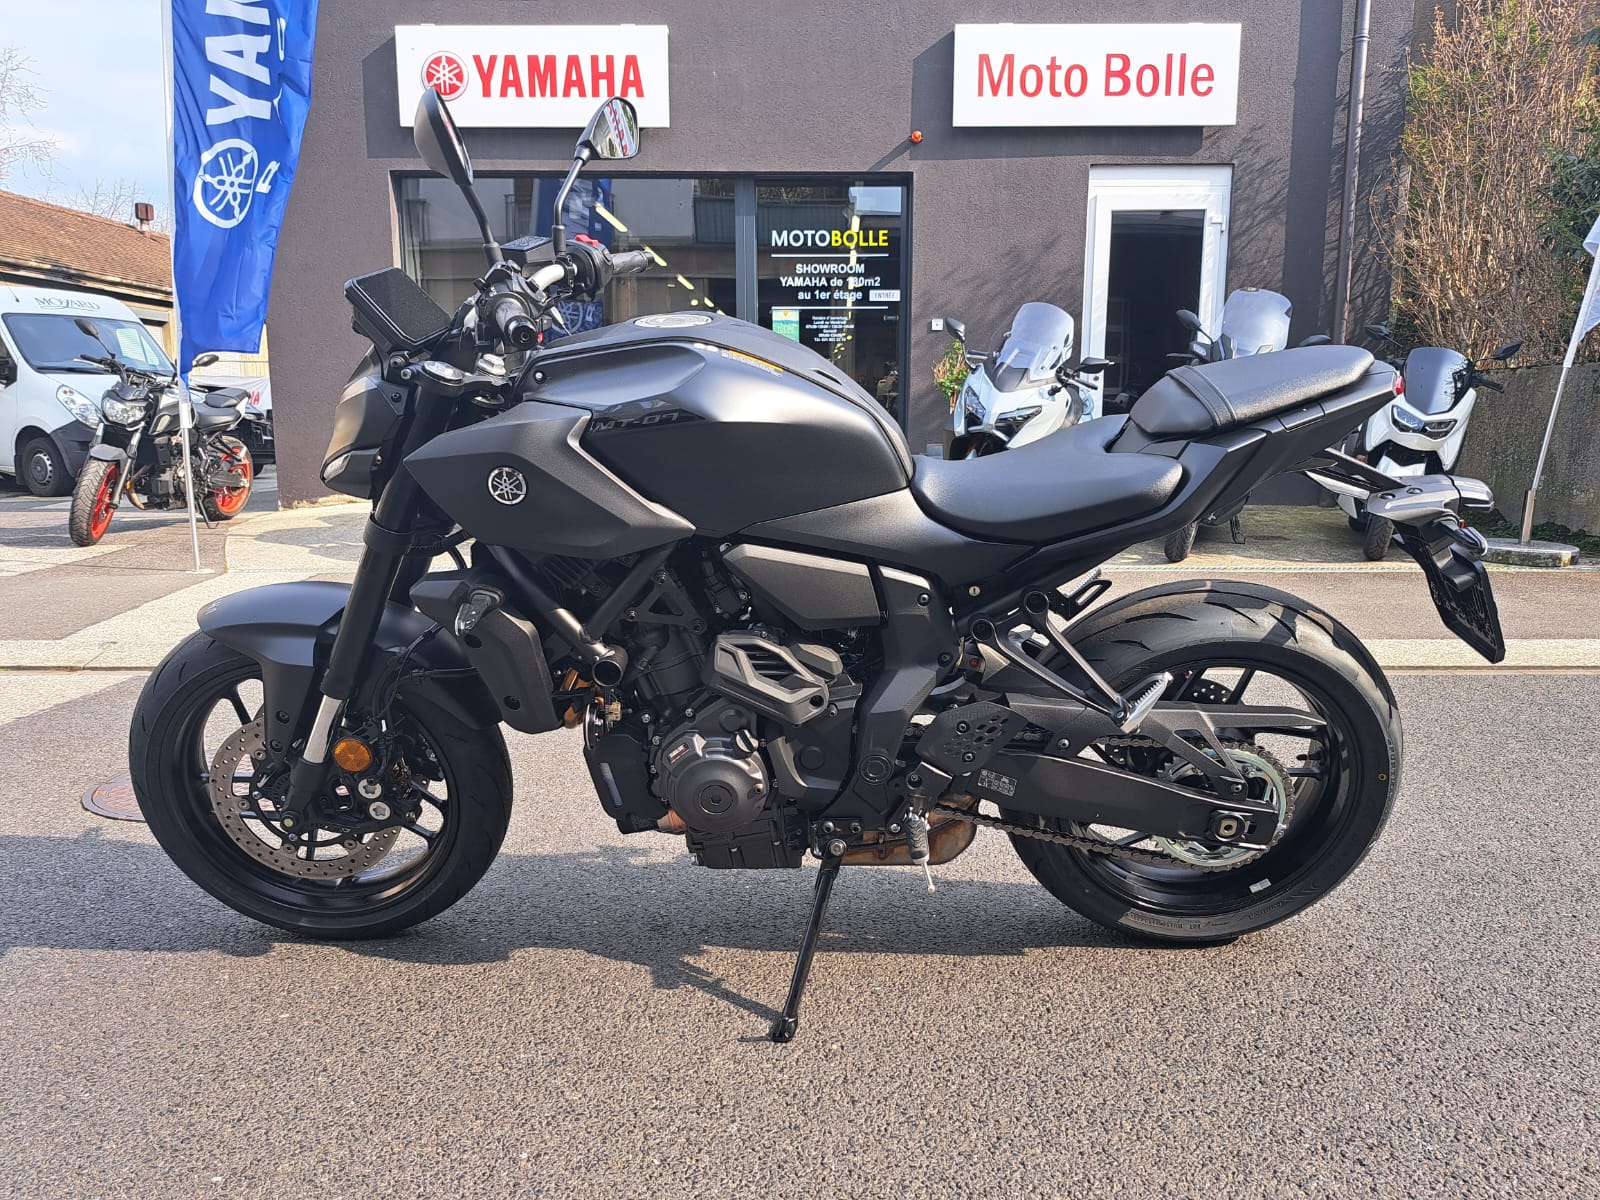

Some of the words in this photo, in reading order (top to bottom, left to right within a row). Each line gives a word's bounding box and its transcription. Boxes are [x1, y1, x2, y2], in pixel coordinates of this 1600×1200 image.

[472, 54, 645, 98] YAMAHA
[977, 53, 1088, 98] Moto
[1103, 52, 1216, 97] Bolle
[771, 229, 889, 247] MOTOBOLLE
[795, 263, 866, 274] SHOWROOM
[779, 276, 828, 287] YAMAHA
[829, 276, 843, 287] de
[797, 291, 812, 300] au
[814, 289, 831, 300] 1er
[833, 289, 863, 302] étage
[592, 412, 680, 433] MT-07
